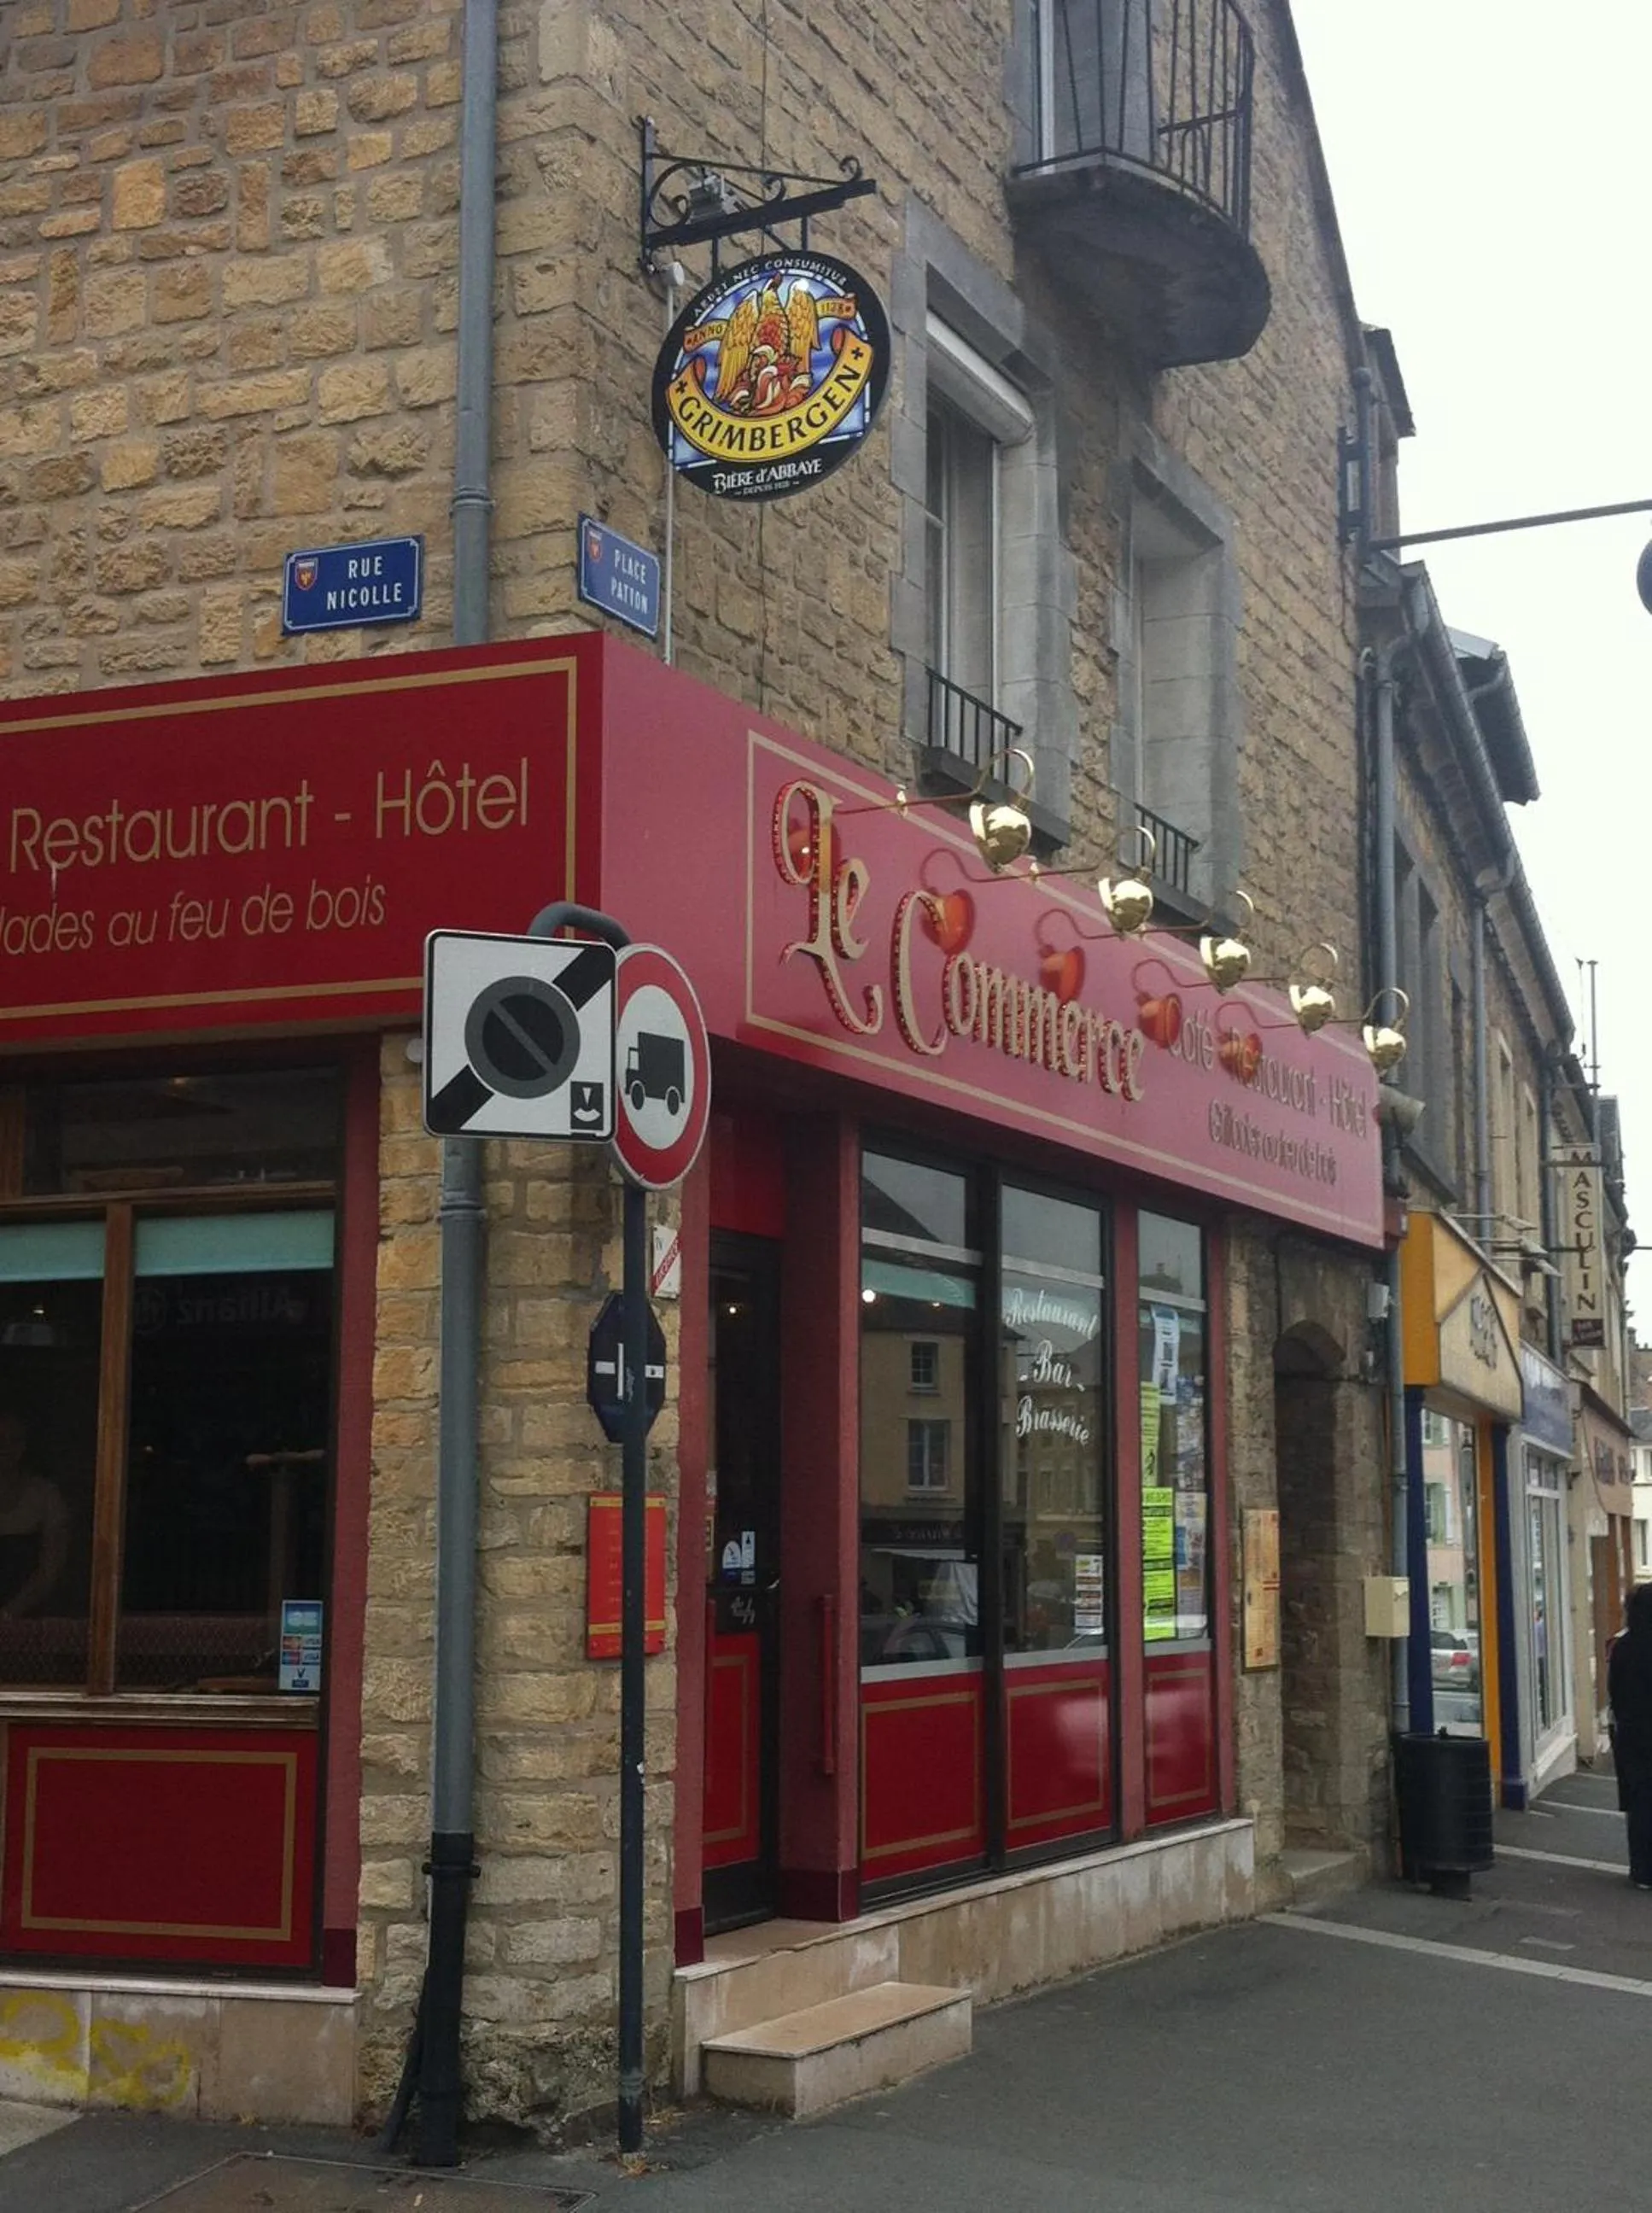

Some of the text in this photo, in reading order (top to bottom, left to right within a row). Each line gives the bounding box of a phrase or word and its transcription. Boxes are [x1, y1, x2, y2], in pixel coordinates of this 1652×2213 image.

[733, 265, 760, 282] NEC
[764, 258, 848, 286] CONSUMITUR
[693, 325, 723, 344] ANNO
[677, 363, 861, 453] GRIMBERGEN
[347, 555, 384, 579] RUE
[613, 549, 647, 586] PLACE
[326, 582, 403, 611] NICOLLE
[610, 577, 649, 615] PATTON
[9, 779, 315, 873] Restaurant
[376, 756, 528, 838] Hôtel
[108, 909, 158, 947] au
[169, 890, 230, 943] feu
[241, 883, 295, 936] de
[306, 873, 388, 931] bois
[773, 778, 1147, 1102] Le Commerce
[1570, 1150, 1597, 1312] MASCULIN
[1005, 1288, 1098, 1340] Restaurant
[1033, 1339, 1073, 1388] Bar
[1015, 1394, 1091, 1447] Brasserie
